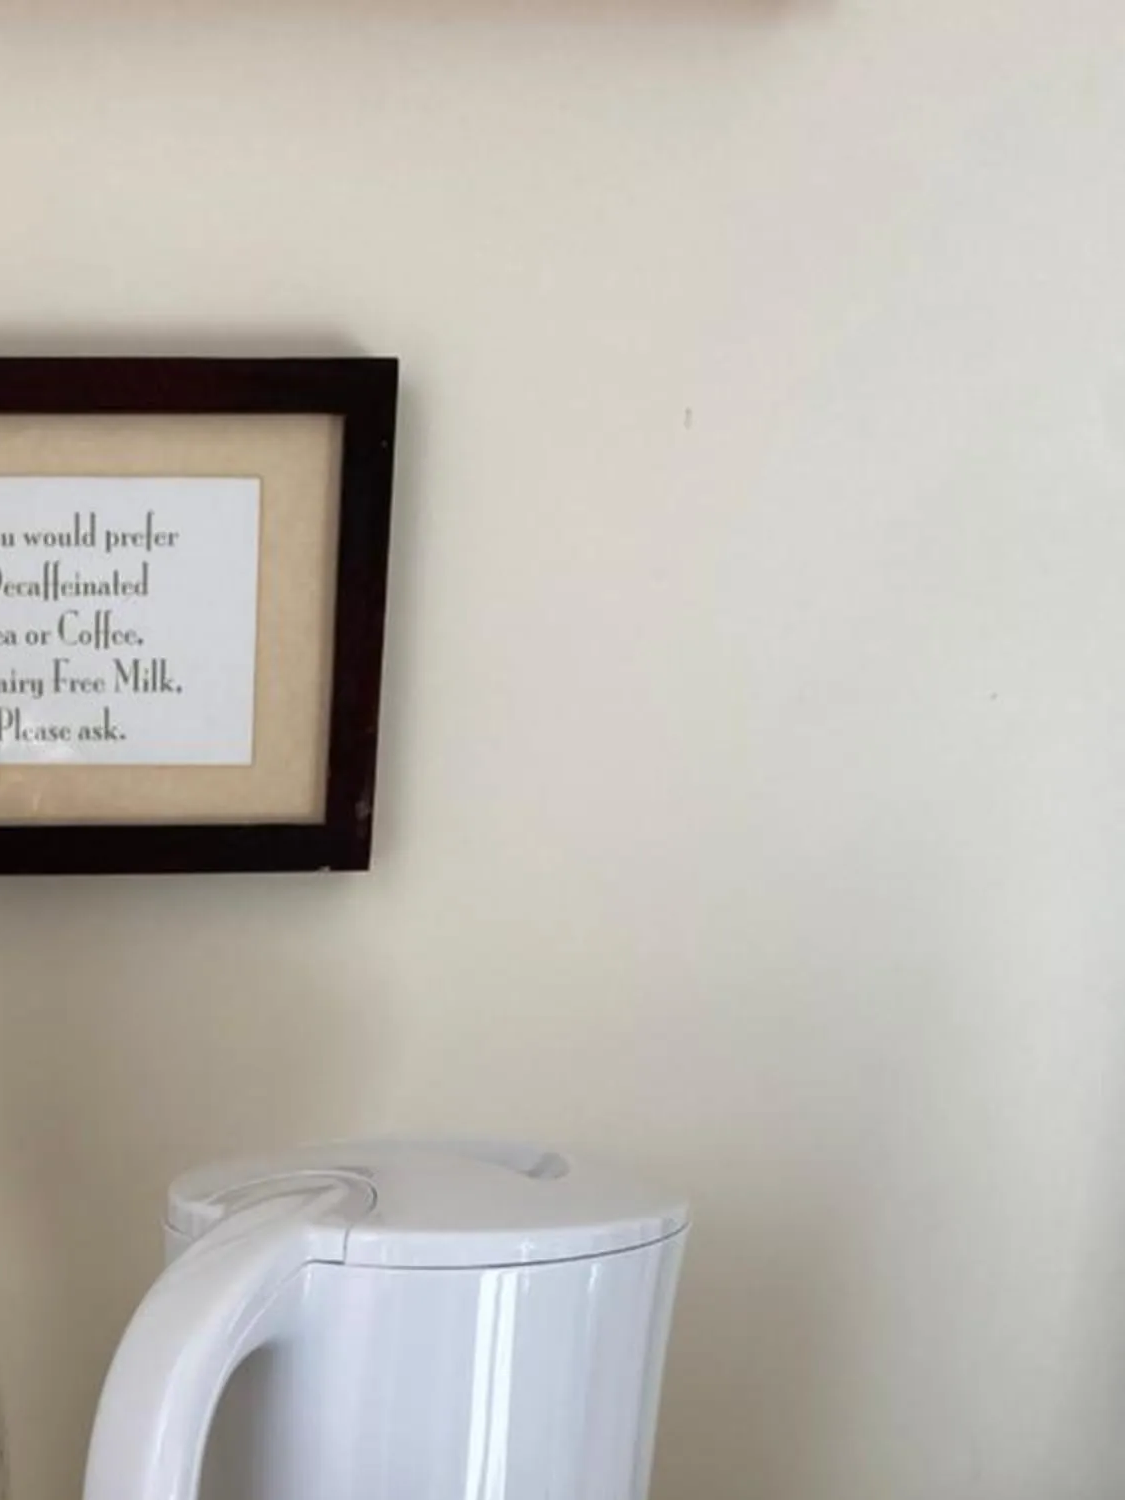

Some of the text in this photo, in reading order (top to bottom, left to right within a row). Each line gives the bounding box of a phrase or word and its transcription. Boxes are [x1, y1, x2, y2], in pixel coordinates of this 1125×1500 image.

[23, 511, 96, 547] would
[105, 510, 179, 553] prefer
[26, 630, 51, 646] or
[53, 658, 106, 694] Free
[114, 658, 183, 695] Milk.
[78, 706, 126, 741] ask.
